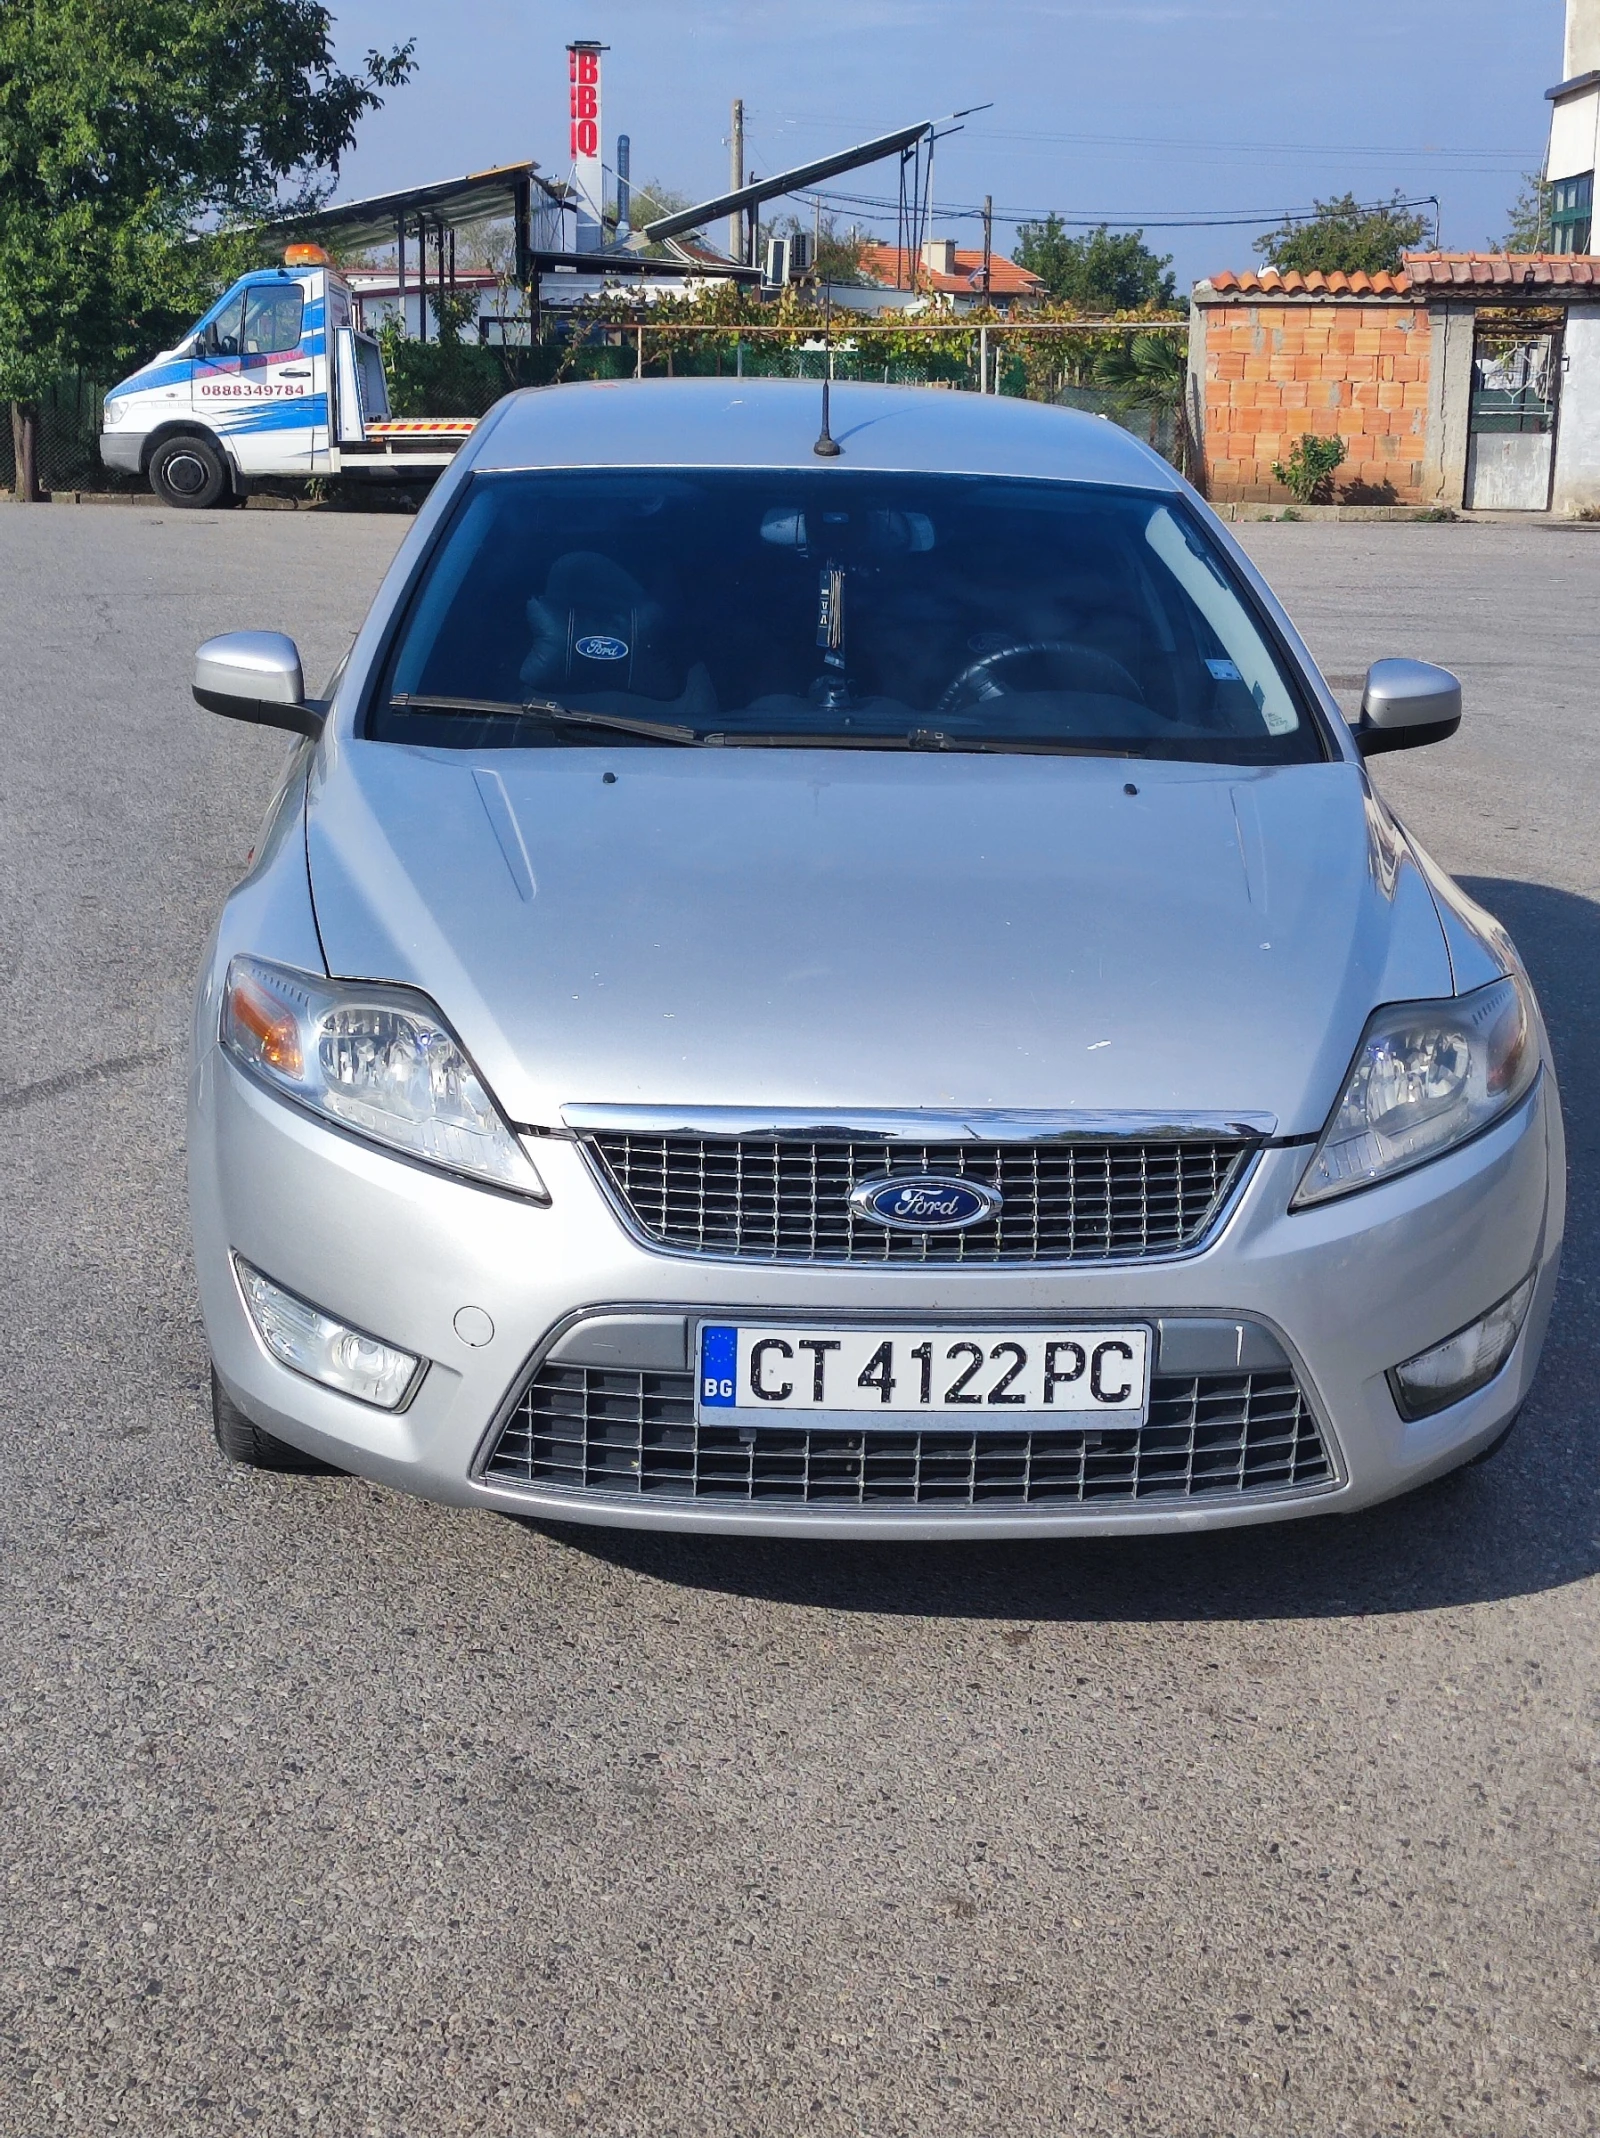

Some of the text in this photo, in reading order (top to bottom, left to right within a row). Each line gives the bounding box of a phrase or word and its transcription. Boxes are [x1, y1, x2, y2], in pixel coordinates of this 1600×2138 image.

[578, 50, 598, 158] BBQ
[201, 384, 305, 396] 0888349784
[586, 639, 619, 656] Ford
[894, 1188, 960, 1215] Ford
[704, 1378, 733, 1398] BG
